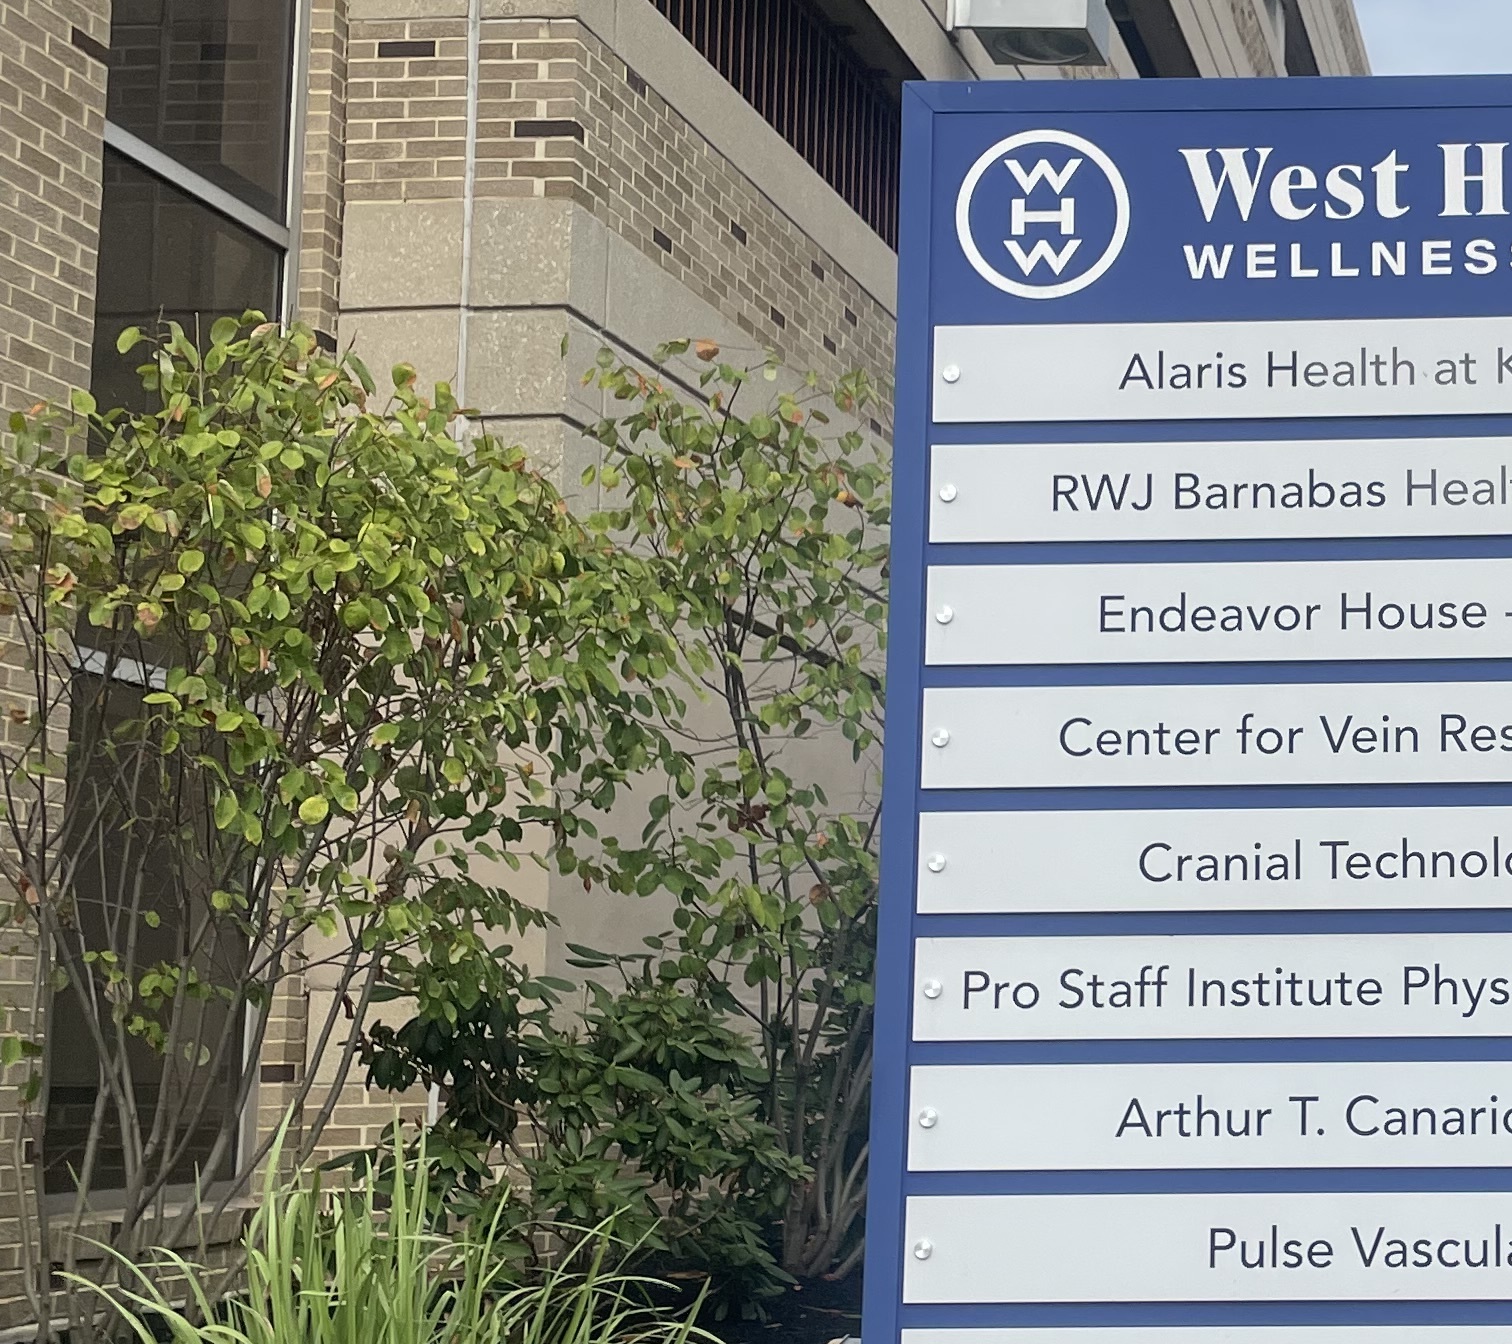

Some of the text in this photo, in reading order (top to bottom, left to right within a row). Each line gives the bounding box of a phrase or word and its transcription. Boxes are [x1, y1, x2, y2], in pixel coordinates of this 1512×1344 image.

[1177, 147, 1411, 223] West
[1118, 349, 1248, 391] Alaris
[1267, 346, 1415, 388] Health
[1434, 352, 1477, 386] at
[1052, 472, 1153, 512] RWJ
[1174, 467, 1387, 510] Barnabas
[1099, 591, 1322, 633] Endeavor
[1340, 591, 1488, 631] House
[1059, 717, 1221, 757] Center
[1235, 712, 1304, 755] for
[1318, 714, 1419, 754] Vein
[1138, 838, 1301, 883] Cranial
[963, 970, 1040, 1010] Pro
[1058, 964, 1170, 1010] Staff
[1188, 966, 1383, 1008] Institute
[1114, 1094, 1273, 1138] Arthur
[1288, 1095, 1325, 1136] T.
[1209, 1224, 1334, 1269] Pulse
